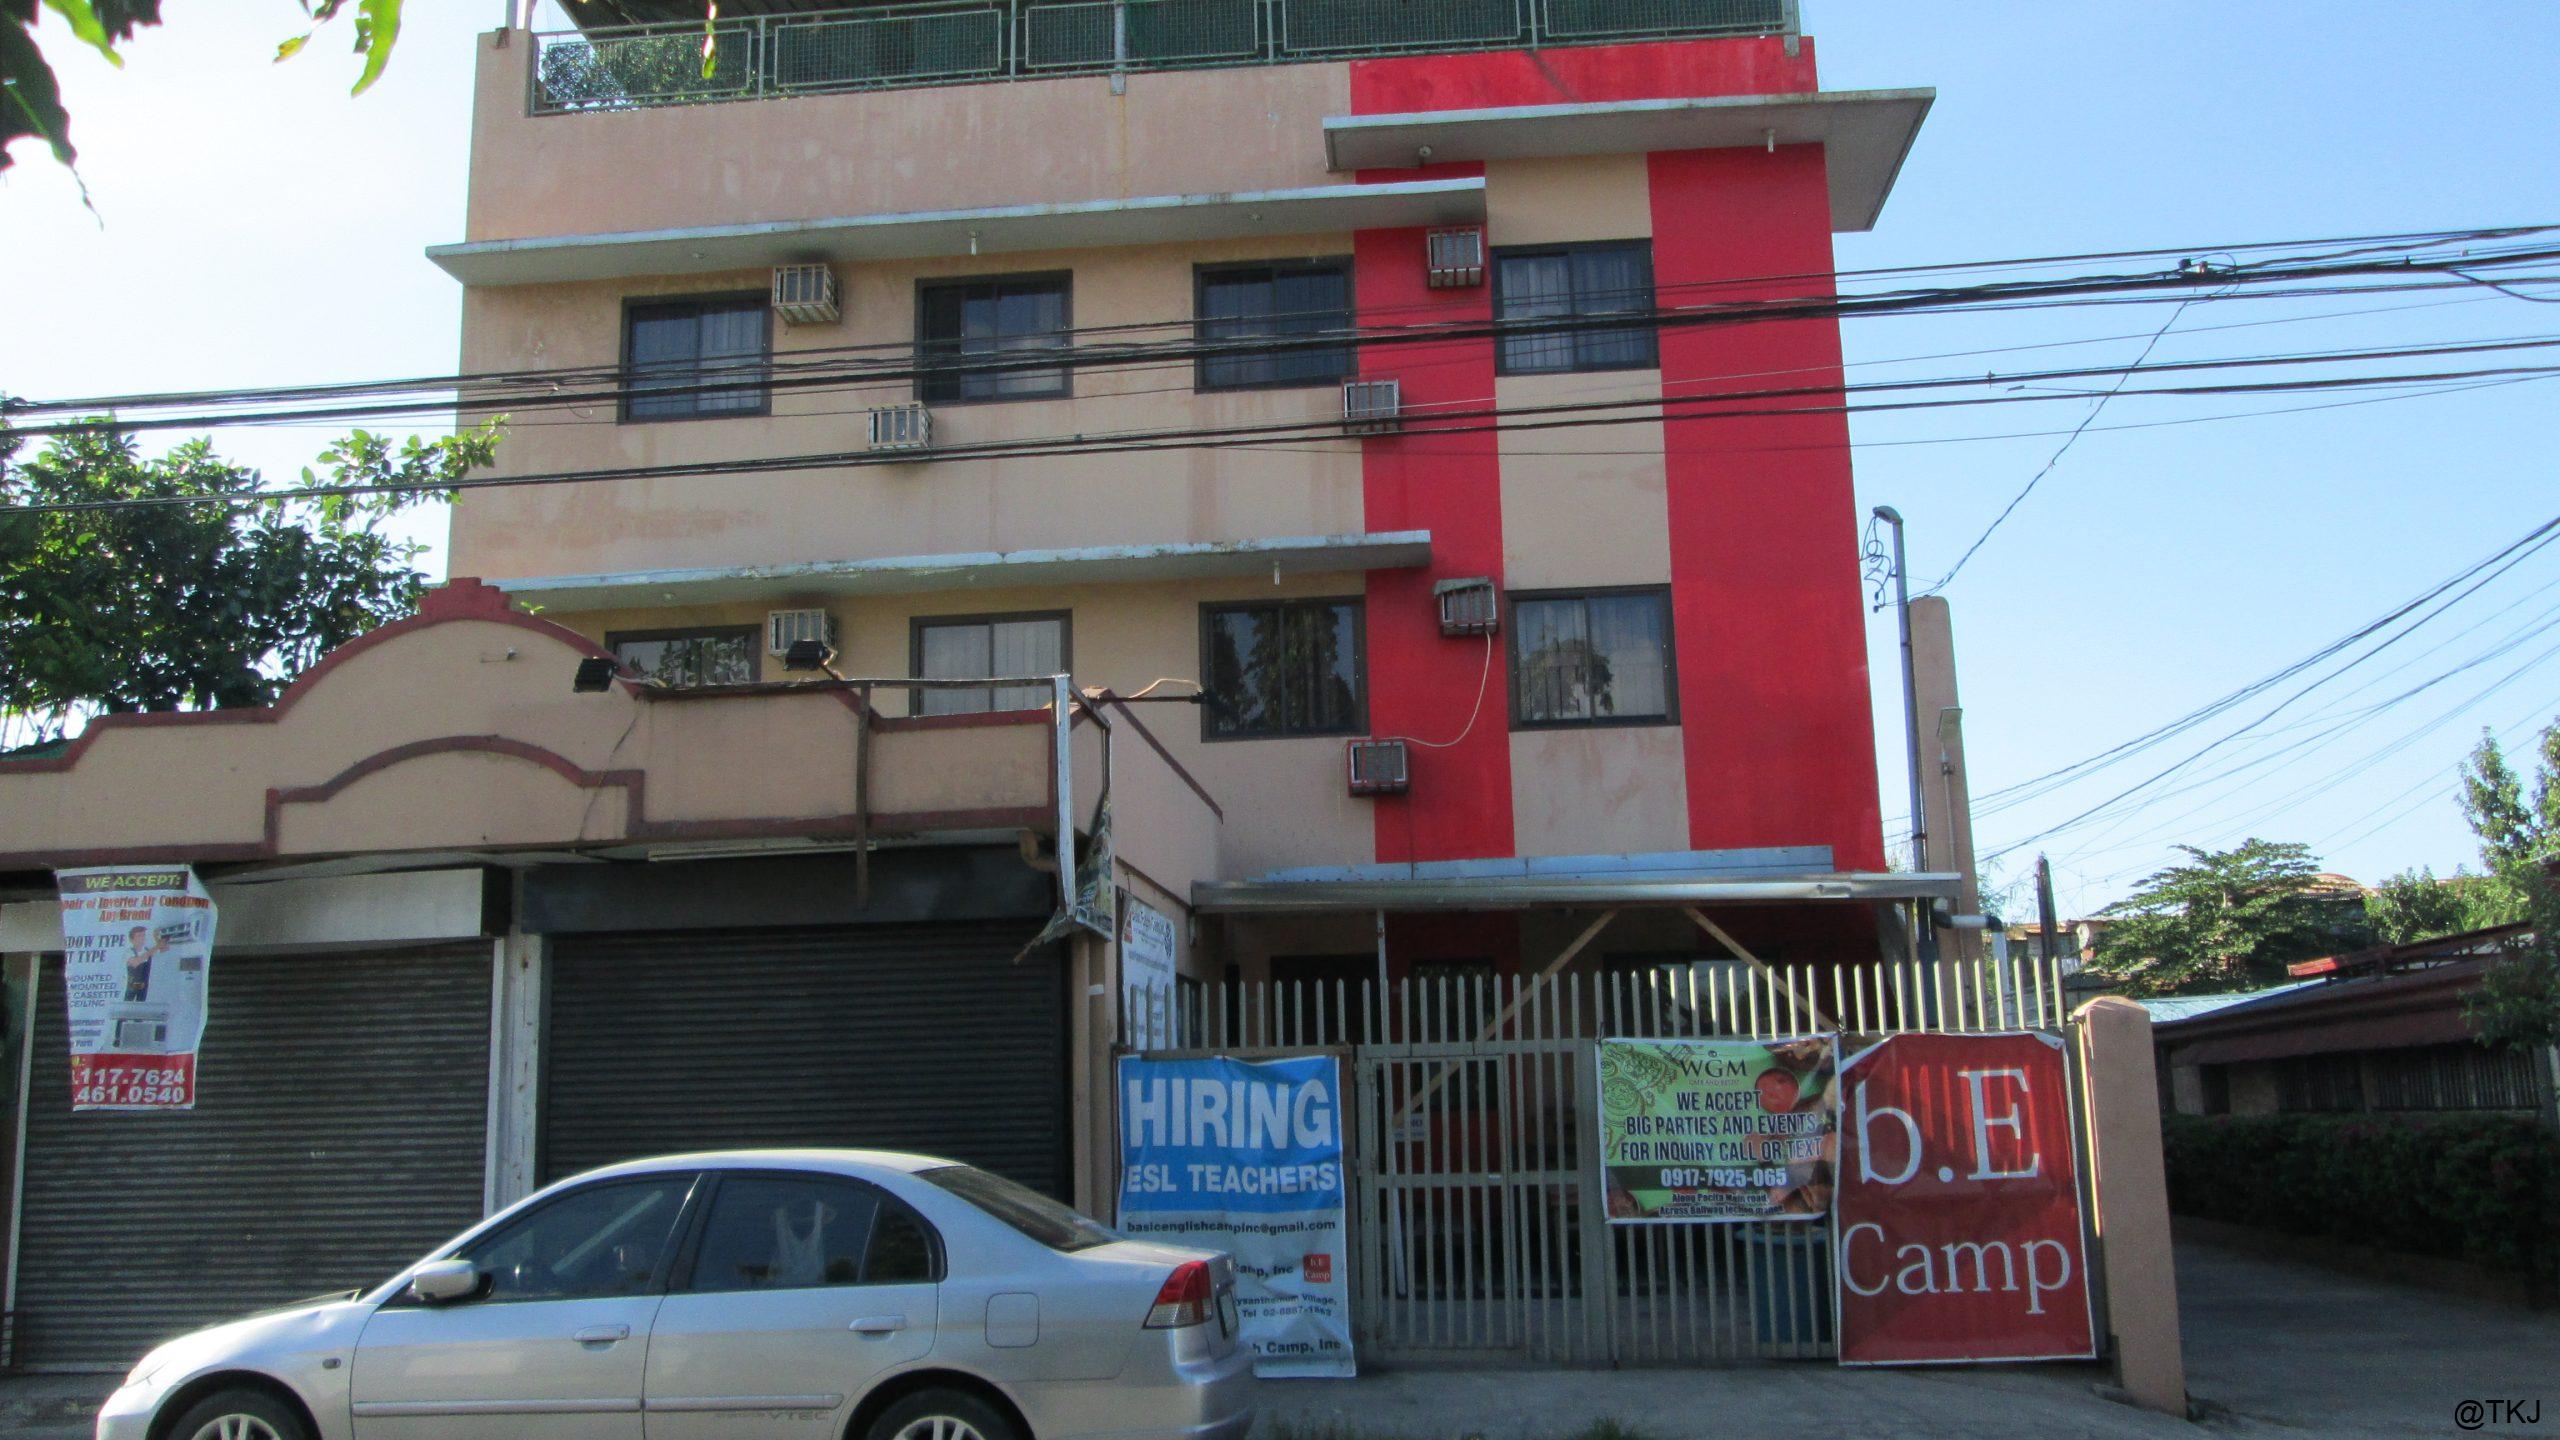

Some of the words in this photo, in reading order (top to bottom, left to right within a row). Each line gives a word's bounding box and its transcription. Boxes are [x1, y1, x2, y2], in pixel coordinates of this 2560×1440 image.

[85, 876, 111, 889] WE
[113, 875, 182, 887] ACCEPT:
[99, 934, 126, 947] TYPE
[81, 950, 106, 963] TYPE
[1679, 1060, 1748, 1077] WGM
[1677, 1092, 1701, 1111] WE
[1705, 1090, 1762, 1111] ACCEPT
[1128, 1078, 1332, 1149] HIRING
[1626, 1117, 1651, 1135] BIG
[1656, 1117, 1717, 1135] PARTIES
[1722, 1116, 1751, 1135] AND
[1759, 1114, 1817, 1135] EVENTS
[1855, 1068, 2040, 1186] b.E
[1621, 1142, 1650, 1161] FOR
[1654, 1142, 1715, 1162] INQUIRY
[1719, 1141, 1757, 1161] CALL
[1761, 1141, 1782, 1160] OR
[1785, 1137, 1823, 1159] TEXT
[1127, 1164, 1177, 1193] ESL
[1187, 1163, 1336, 1195] TEACHERS
[1661, 1167, 1788, 1187] 0917-7925-065
[1659, 1206, 1688, 1215] Across
[1127, 1220, 1335, 1235] basicenglishcampinc@gmail.com
[1273, 1265, 1293, 1275] Inc
[1841, 1222, 2072, 1316] Camp
[1266, 1342, 1314, 1354] Camp,
[1319, 1339, 1341, 1350] Inc
